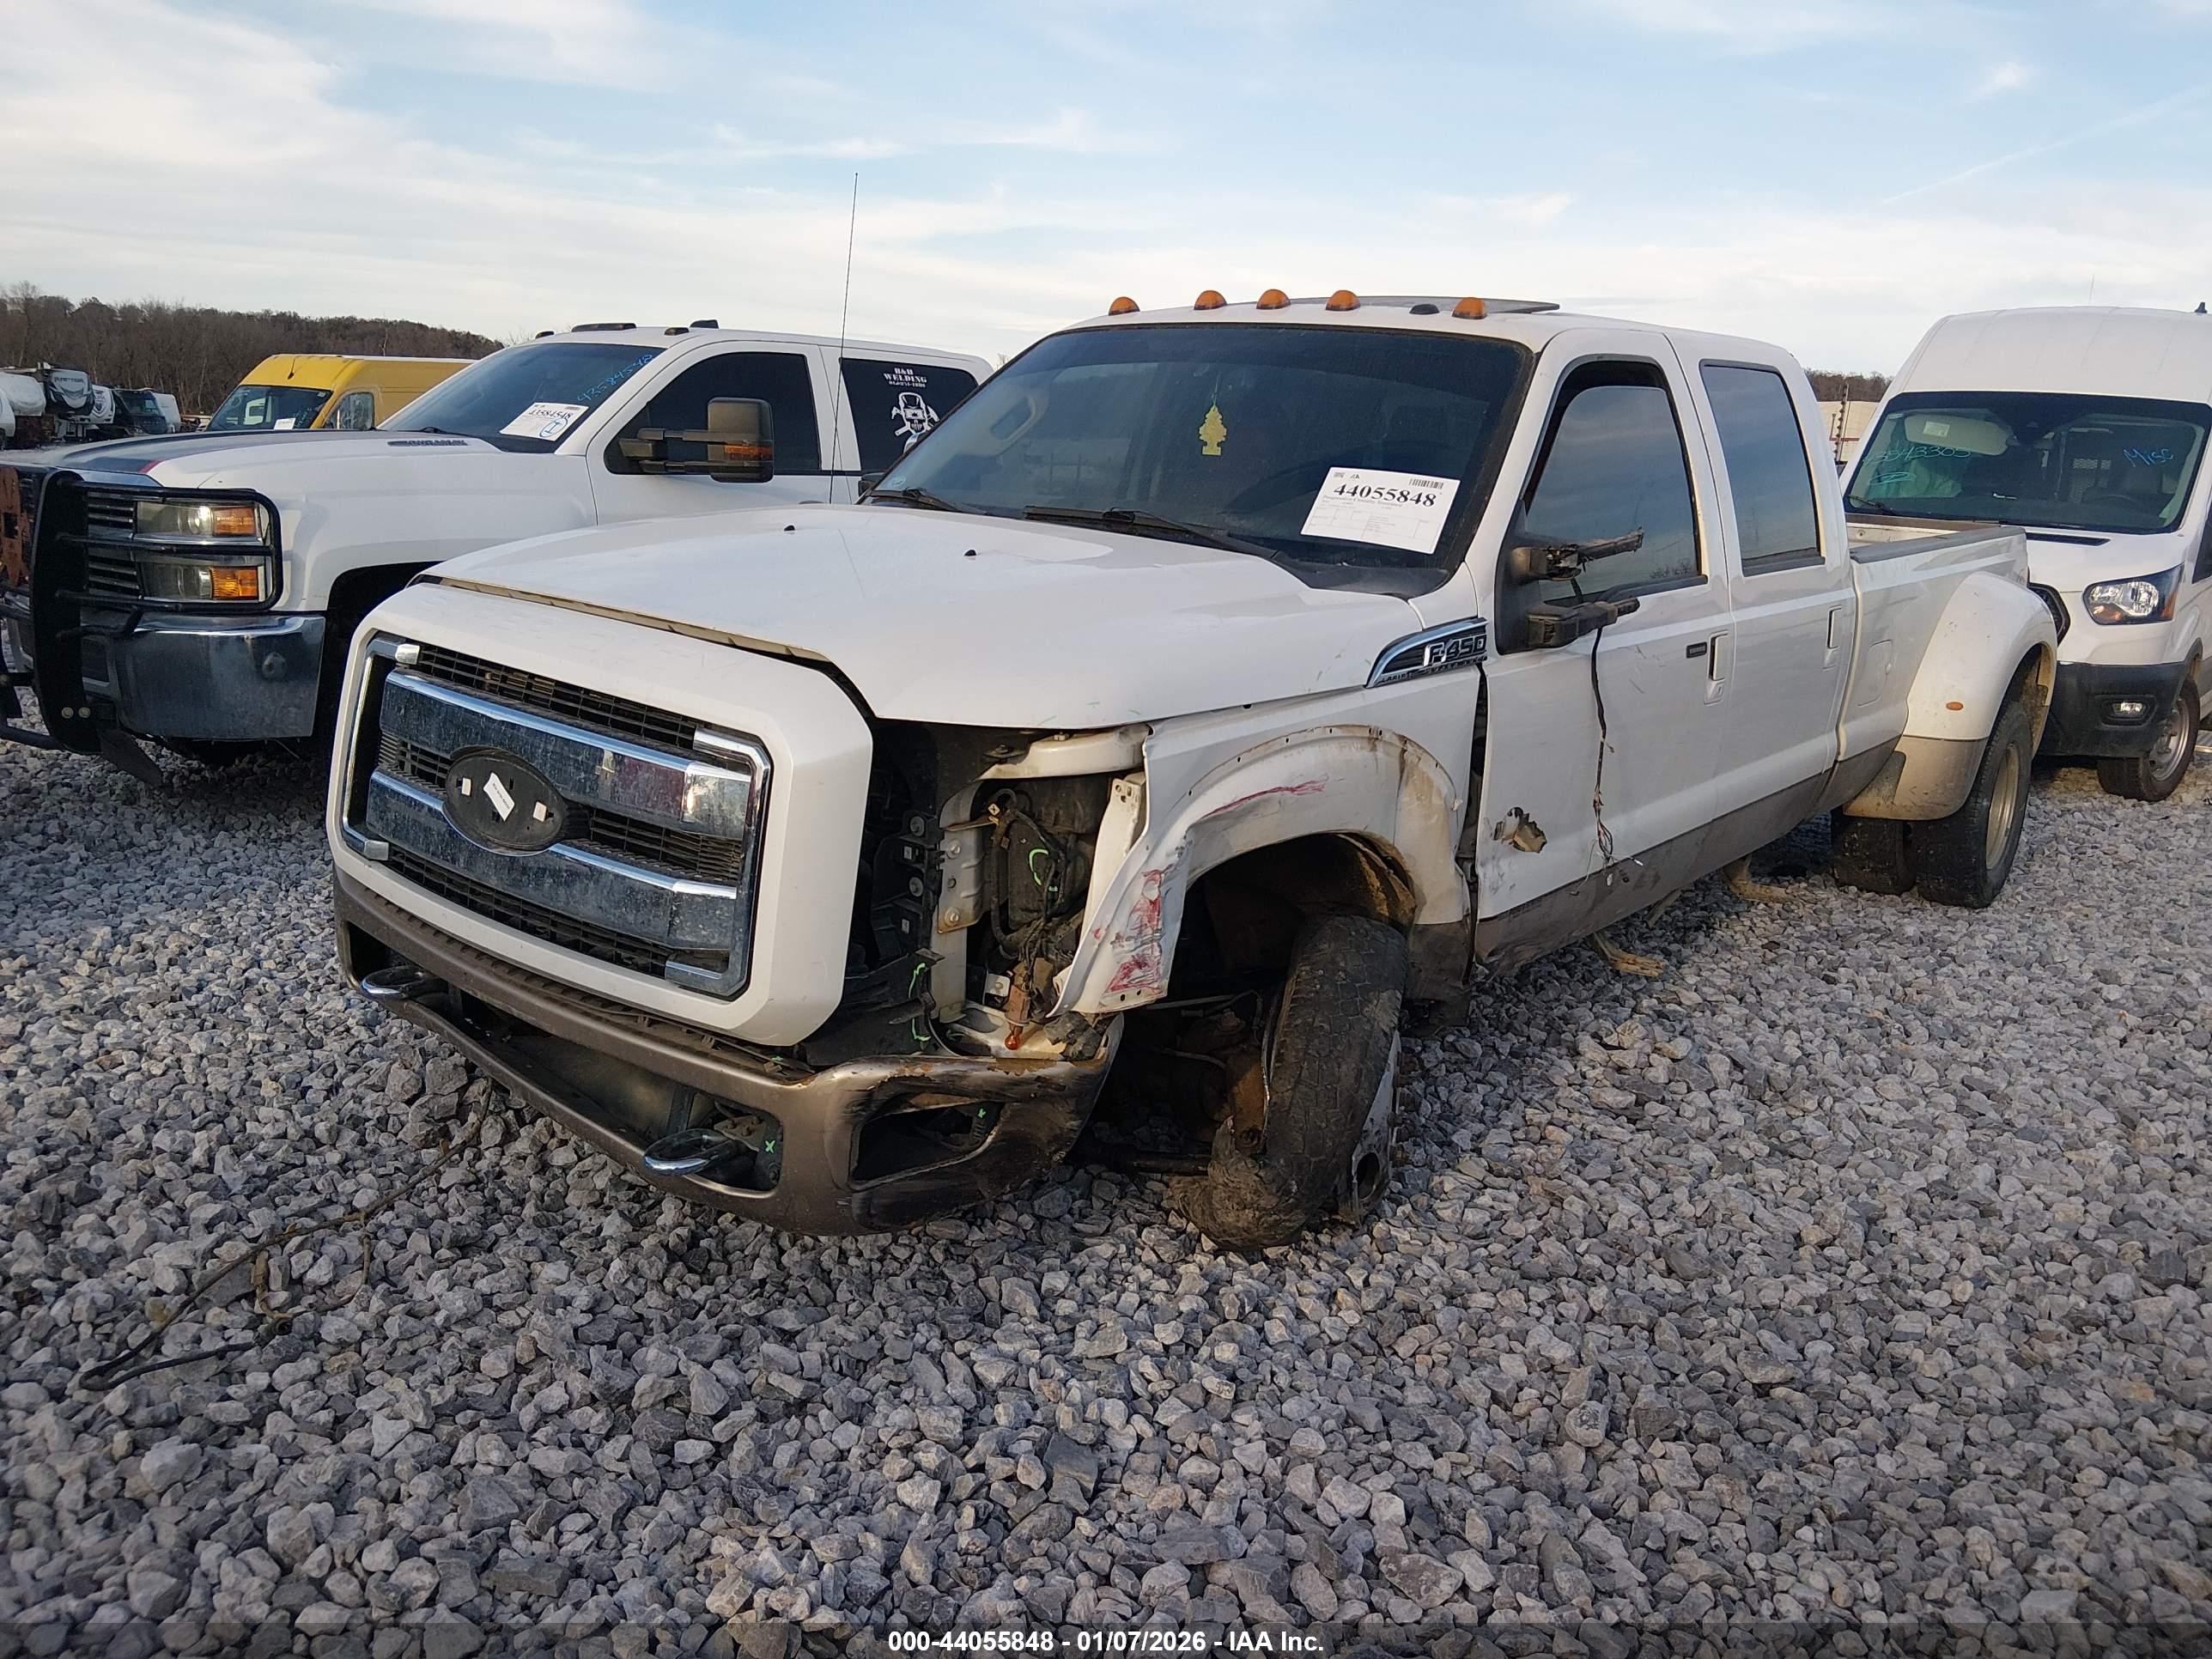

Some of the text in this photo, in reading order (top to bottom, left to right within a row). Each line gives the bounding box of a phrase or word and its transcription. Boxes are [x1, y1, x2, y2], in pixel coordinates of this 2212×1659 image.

[883, 373, 927, 383] WELDING
[1333, 483, 1437, 507] 44055848
[1424, 635, 1486, 667] F-450
